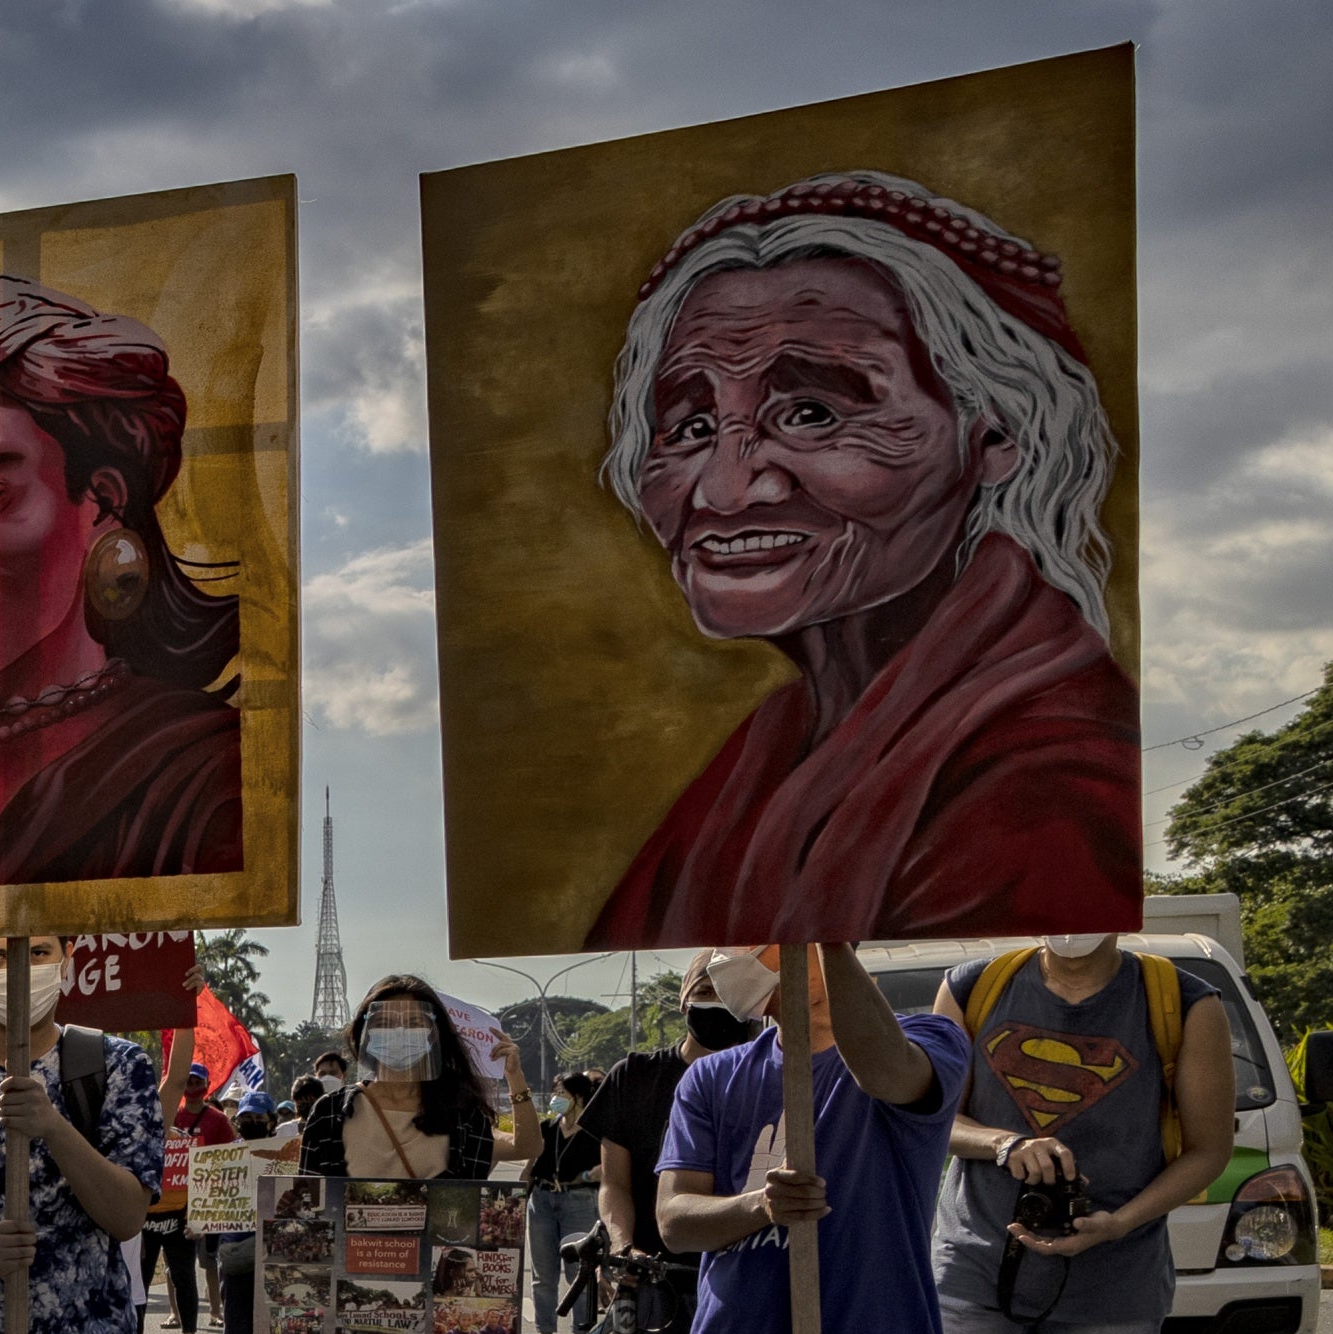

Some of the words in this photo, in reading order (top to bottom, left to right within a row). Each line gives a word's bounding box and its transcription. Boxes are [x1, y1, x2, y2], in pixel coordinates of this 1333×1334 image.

[448, 1007, 471, 1023] AVE
[164, 1137, 199, 1149] PEOPLE
[193, 1145, 249, 1164] UPROOT
[192, 1165, 248, 1184] SYSTEM
[208, 1186, 240, 1198] END
[190, 1196, 252, 1210] CLIMATE
[201, 1222, 243, 1231] AMIHAN
[350, 1238, 383, 1248] bakwit
[384, 1239, 416, 1249] school
[356, 1249, 364, 1257] is
[374, 1249, 397, 1258] form
[398, 1249, 410, 1259] of
[358, 1259, 406, 1269] resistance
[387, 1320, 420, 1330] LAW!
